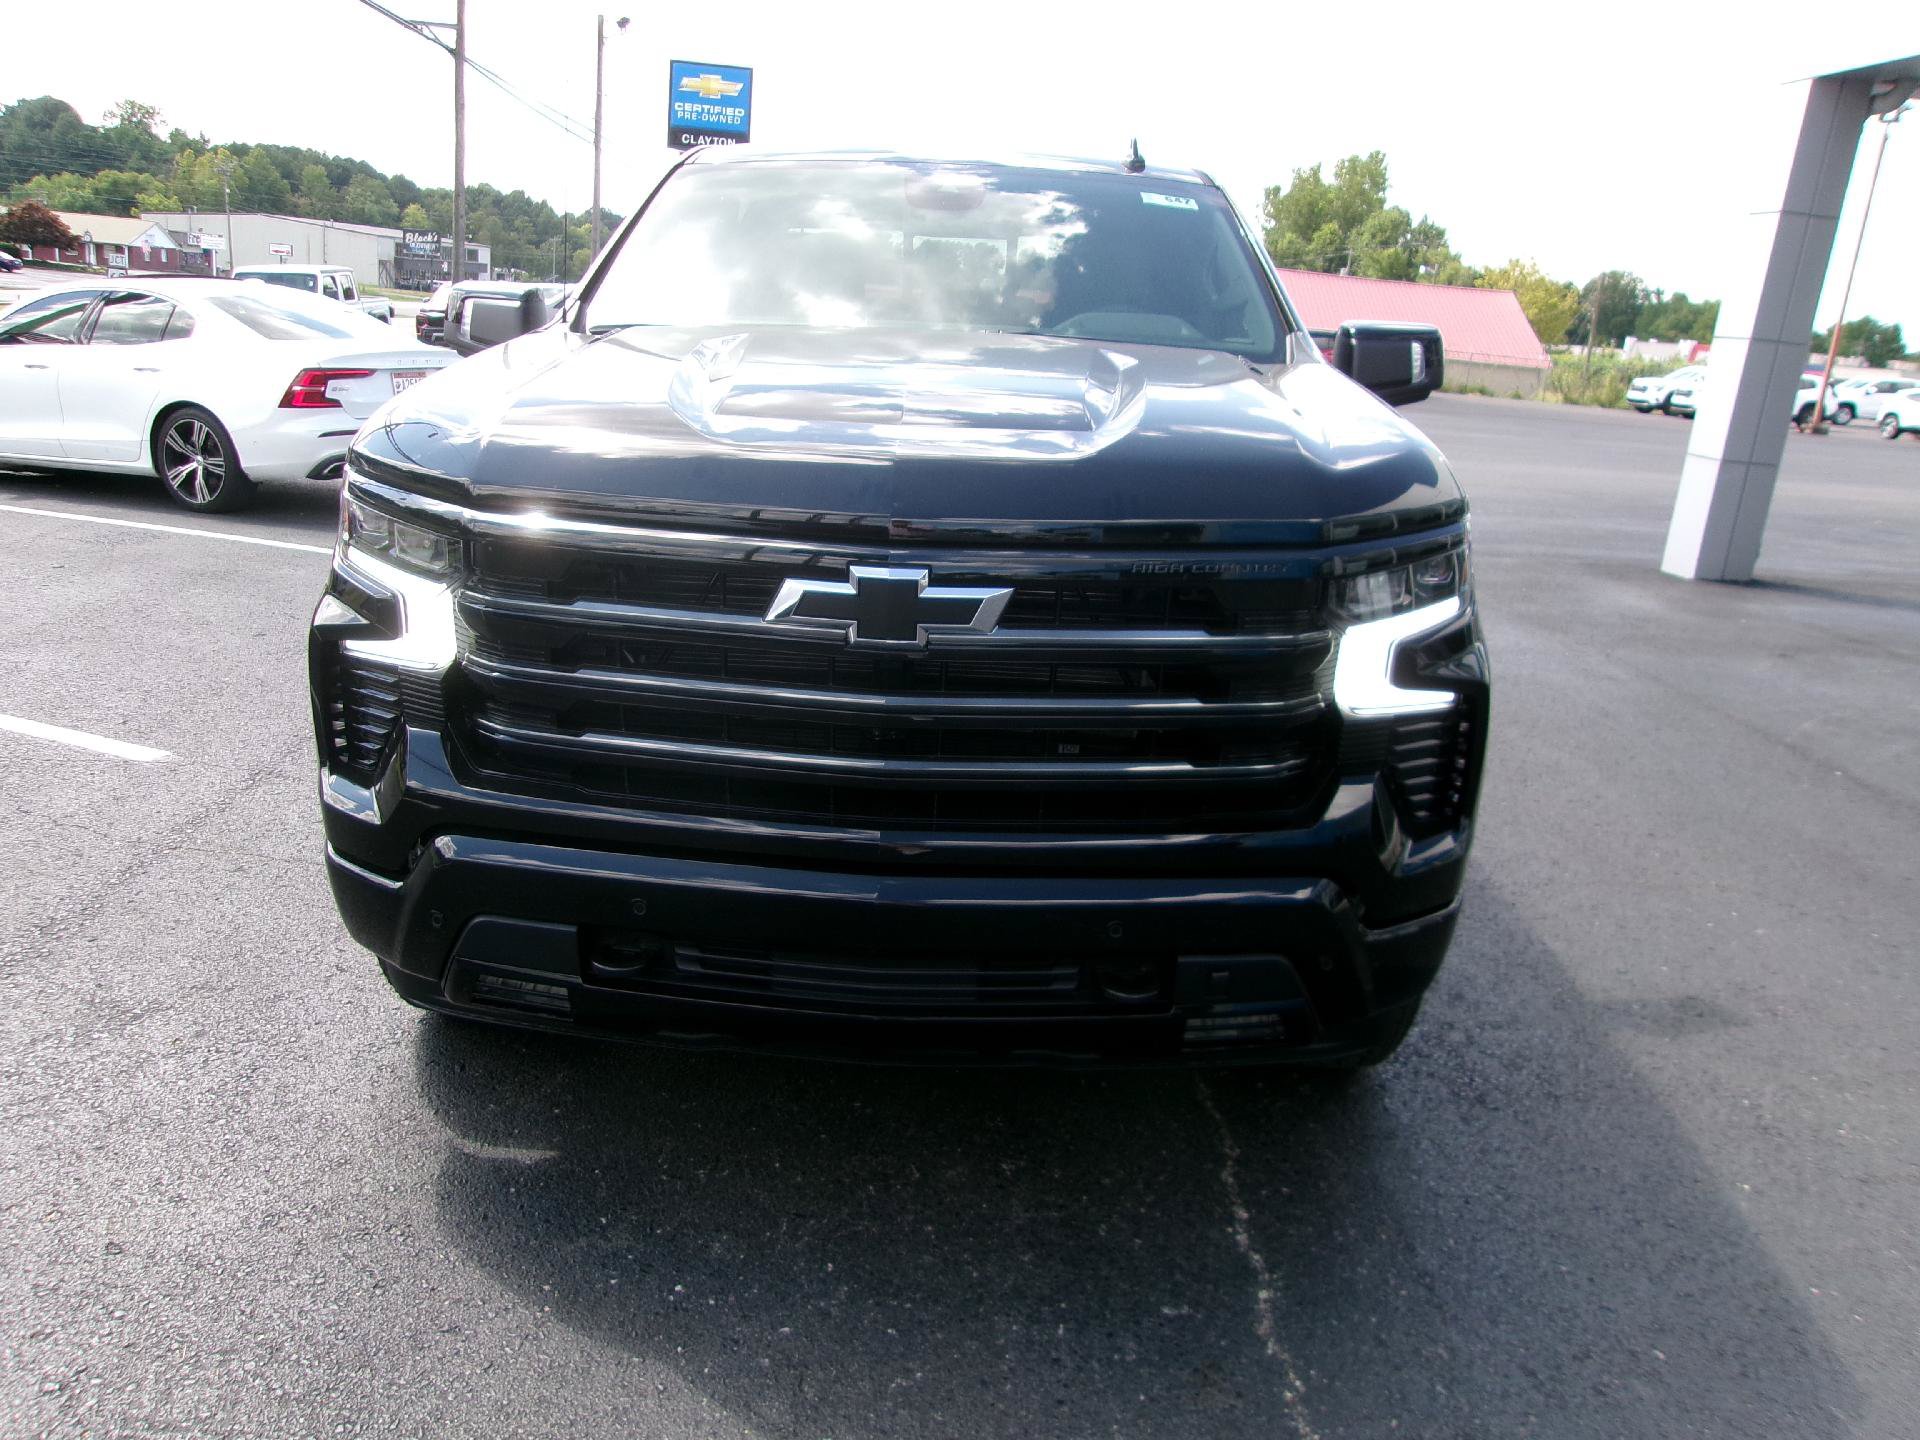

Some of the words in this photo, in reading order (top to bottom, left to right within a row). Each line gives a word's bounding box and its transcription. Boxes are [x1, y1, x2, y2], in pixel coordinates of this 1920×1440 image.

[674, 102, 745, 117] CERTIFIED
[677, 111, 741, 125] PRE-OWNED
[681, 133, 736, 146] CLAYTON
[1131, 560, 1184, 574] HIGH
